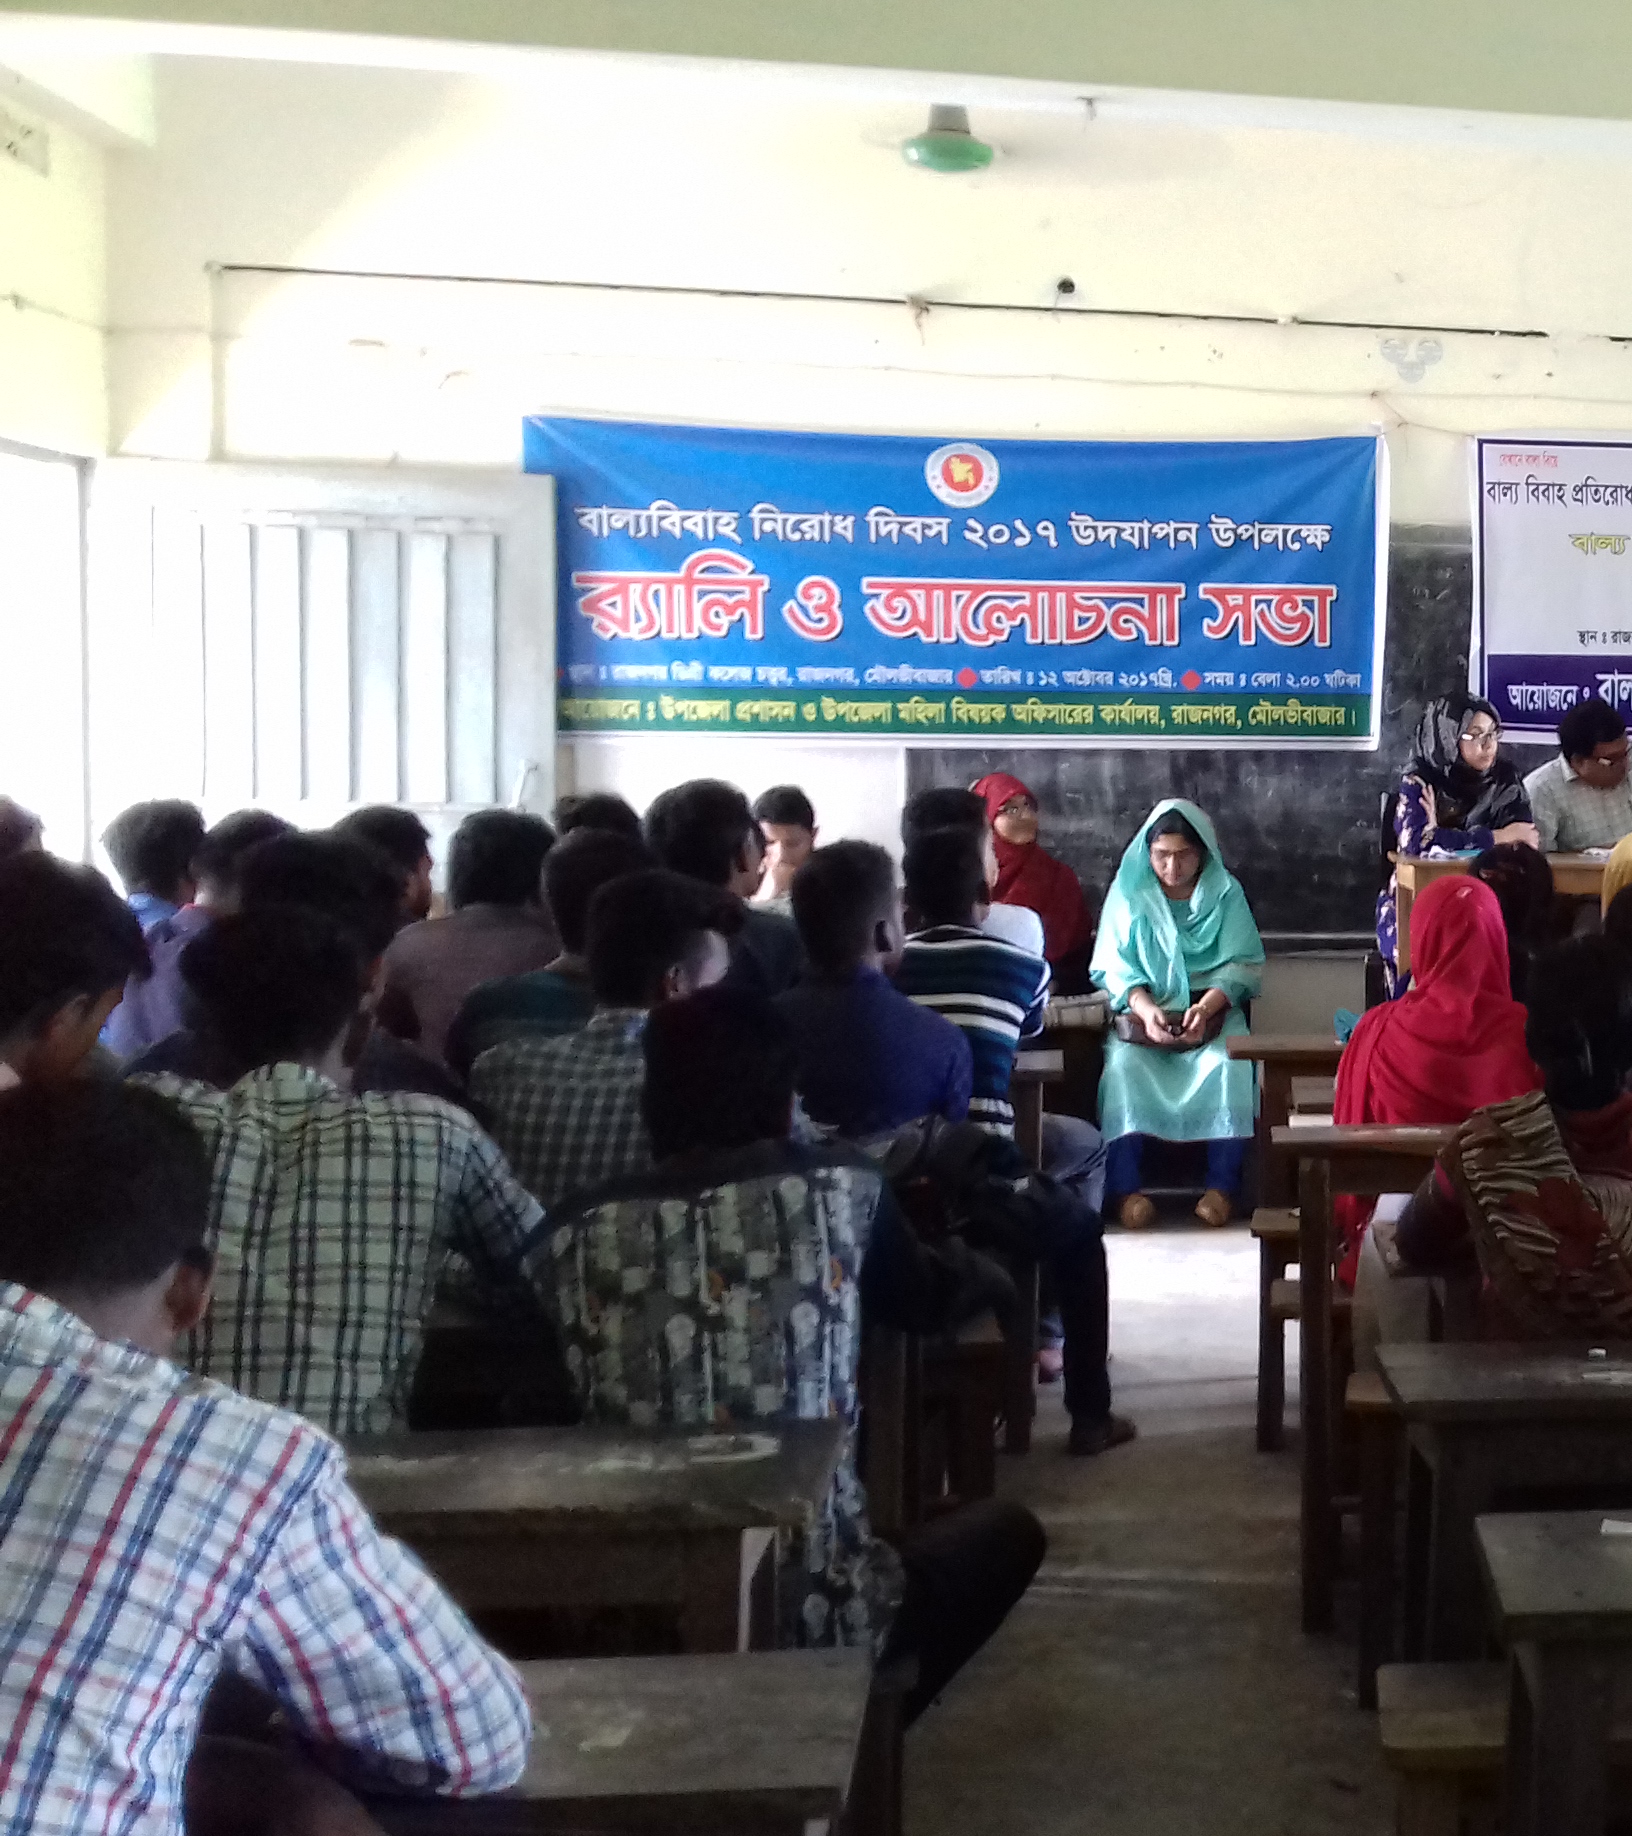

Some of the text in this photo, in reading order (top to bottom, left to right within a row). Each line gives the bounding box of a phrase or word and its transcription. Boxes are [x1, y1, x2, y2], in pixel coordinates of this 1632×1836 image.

[1486, 480, 1519, 505] বাল্য
[1525, 474, 1567, 508] বিবাহ
[574, 499, 1333, 552] বাল্যবিবাহ নিরোধ দিবস ২০১৭ উদযাপন উপলক্ষে
[1569, 531, 1630, 556] বাল্য
[782, 575, 844, 642] ও
[861, 576, 1187, 647] আলোচনা
[1199, 583, 1338, 649] সভা
[1039, 670, 1060, 687] ১২
[821, 695, 892, 722] উপজেলা
